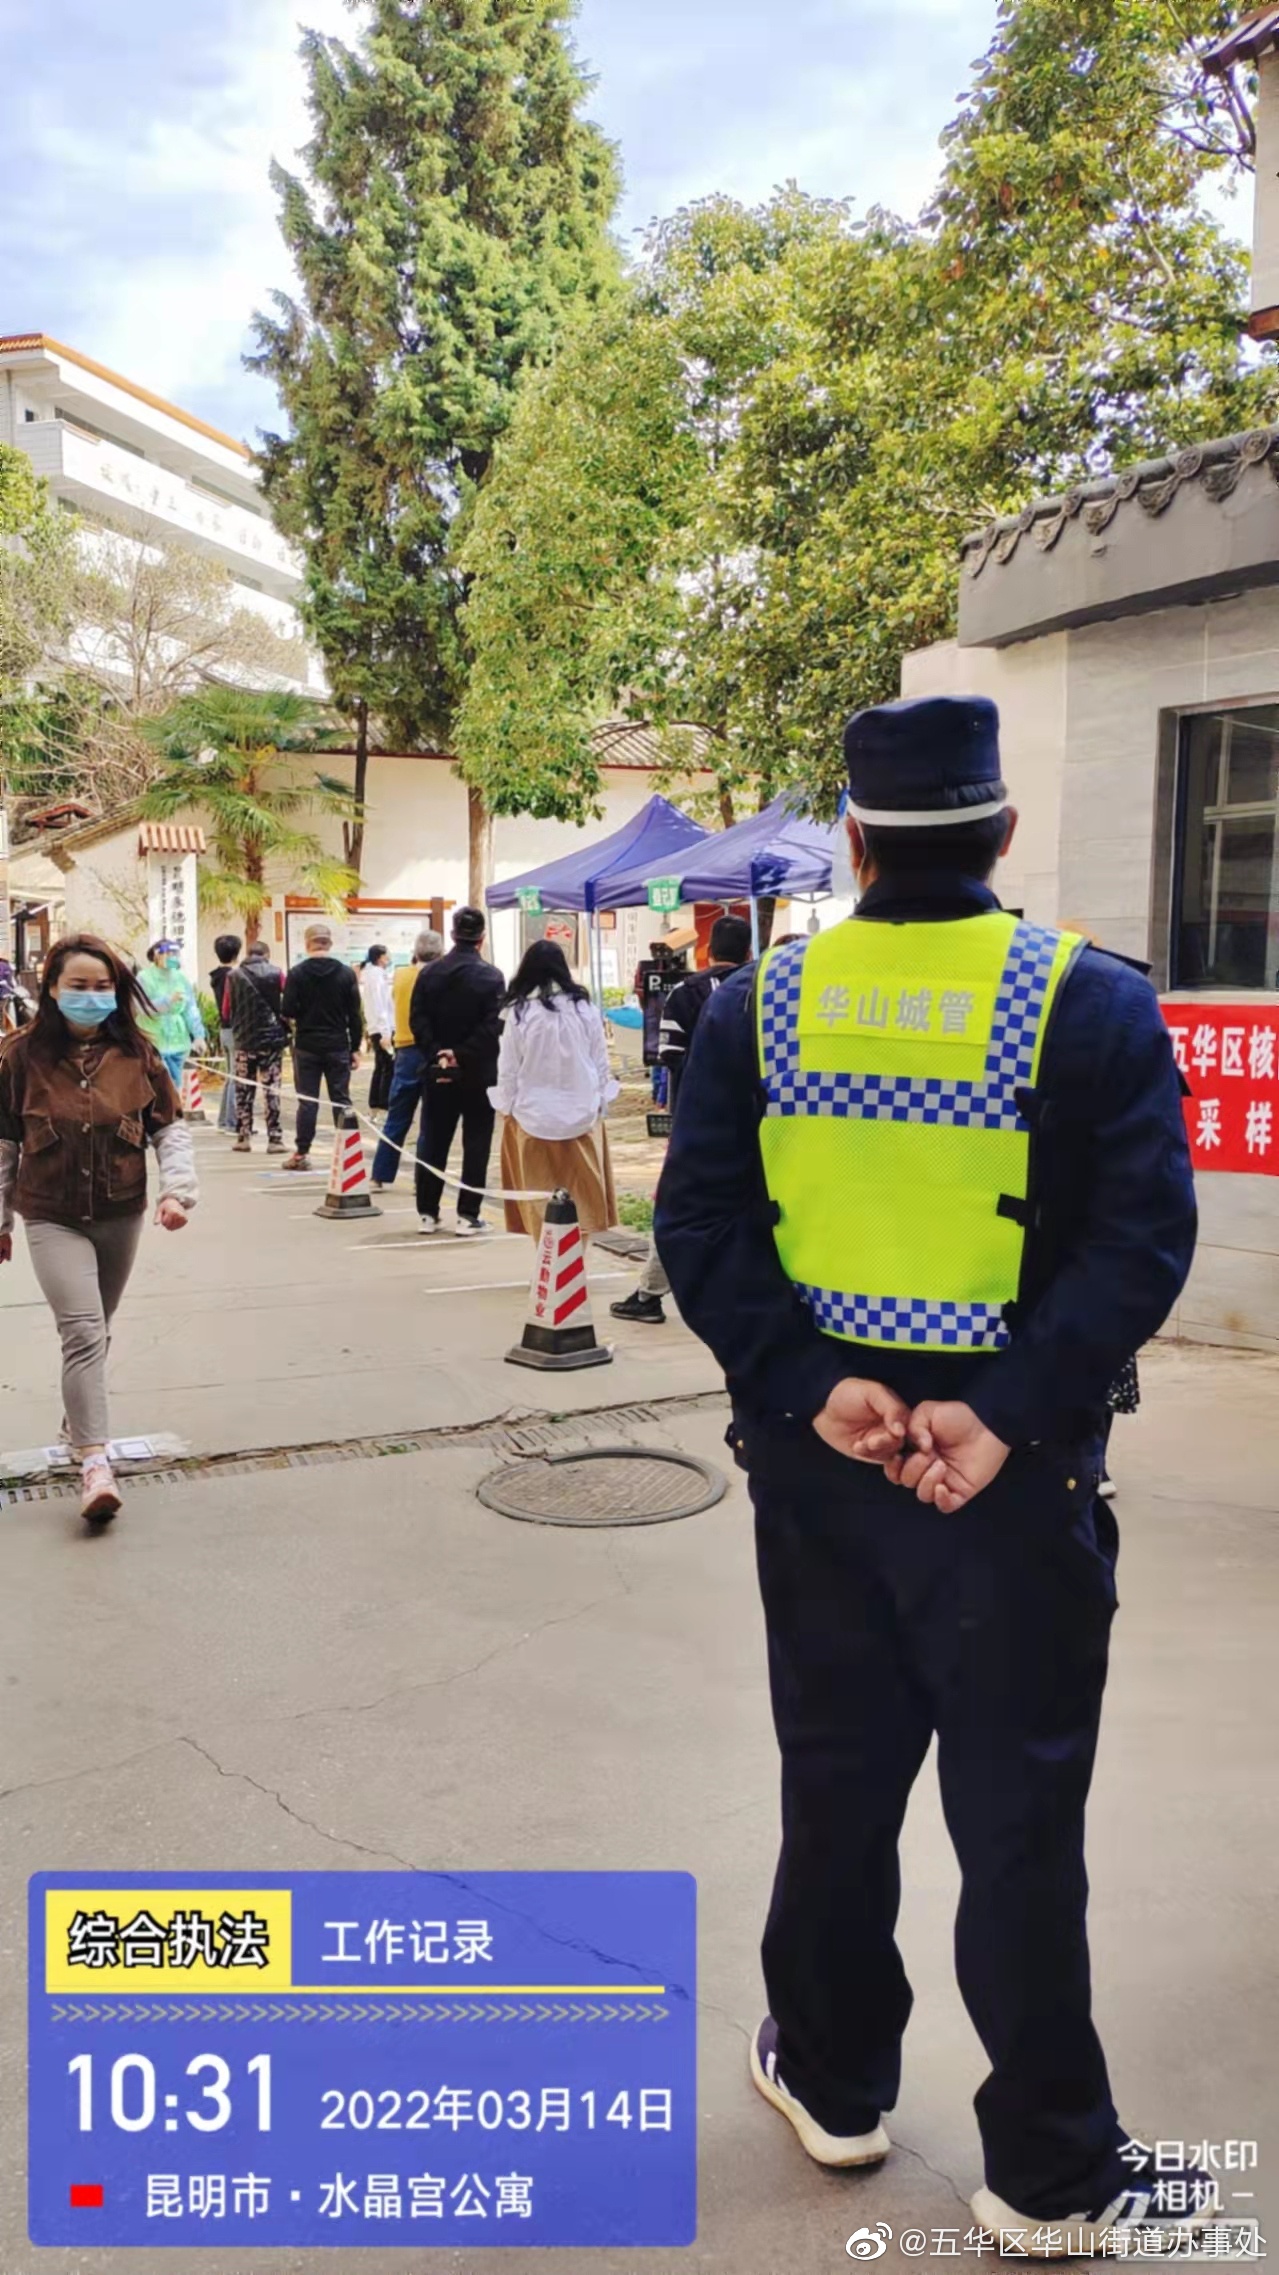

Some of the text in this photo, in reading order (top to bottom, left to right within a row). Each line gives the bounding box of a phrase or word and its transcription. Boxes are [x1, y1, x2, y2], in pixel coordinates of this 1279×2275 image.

[816, 985, 976, 1035] 华山城管
[1168, 1024, 1279, 1080] 五华区核
[1196, 1098, 1273, 1156] 采样
